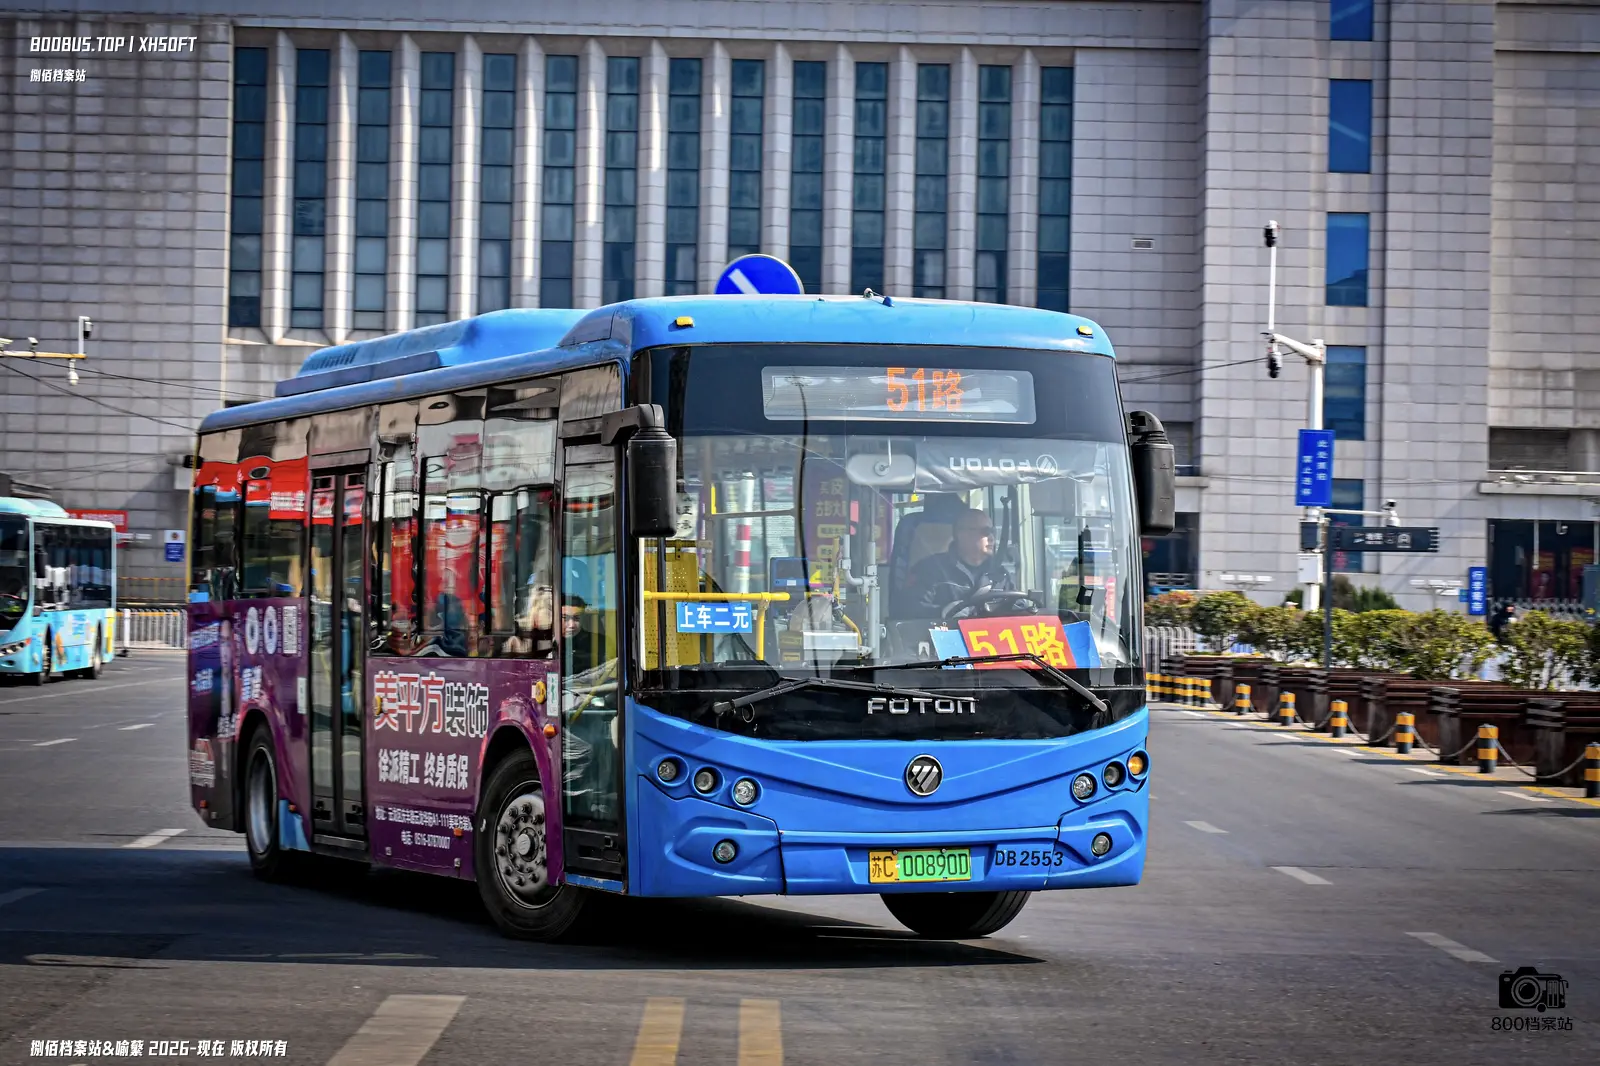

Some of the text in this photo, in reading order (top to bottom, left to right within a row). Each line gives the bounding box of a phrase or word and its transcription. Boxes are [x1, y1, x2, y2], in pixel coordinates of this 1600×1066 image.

[886, 367, 965, 412] 51路
[680, 605, 750, 630] 上车二元
[967, 622, 1069, 667] 51路
[374, 670, 489, 738] 美平方装饰
[867, 697, 976, 715] FOTON
[423, 751, 468, 790] 终身质保
